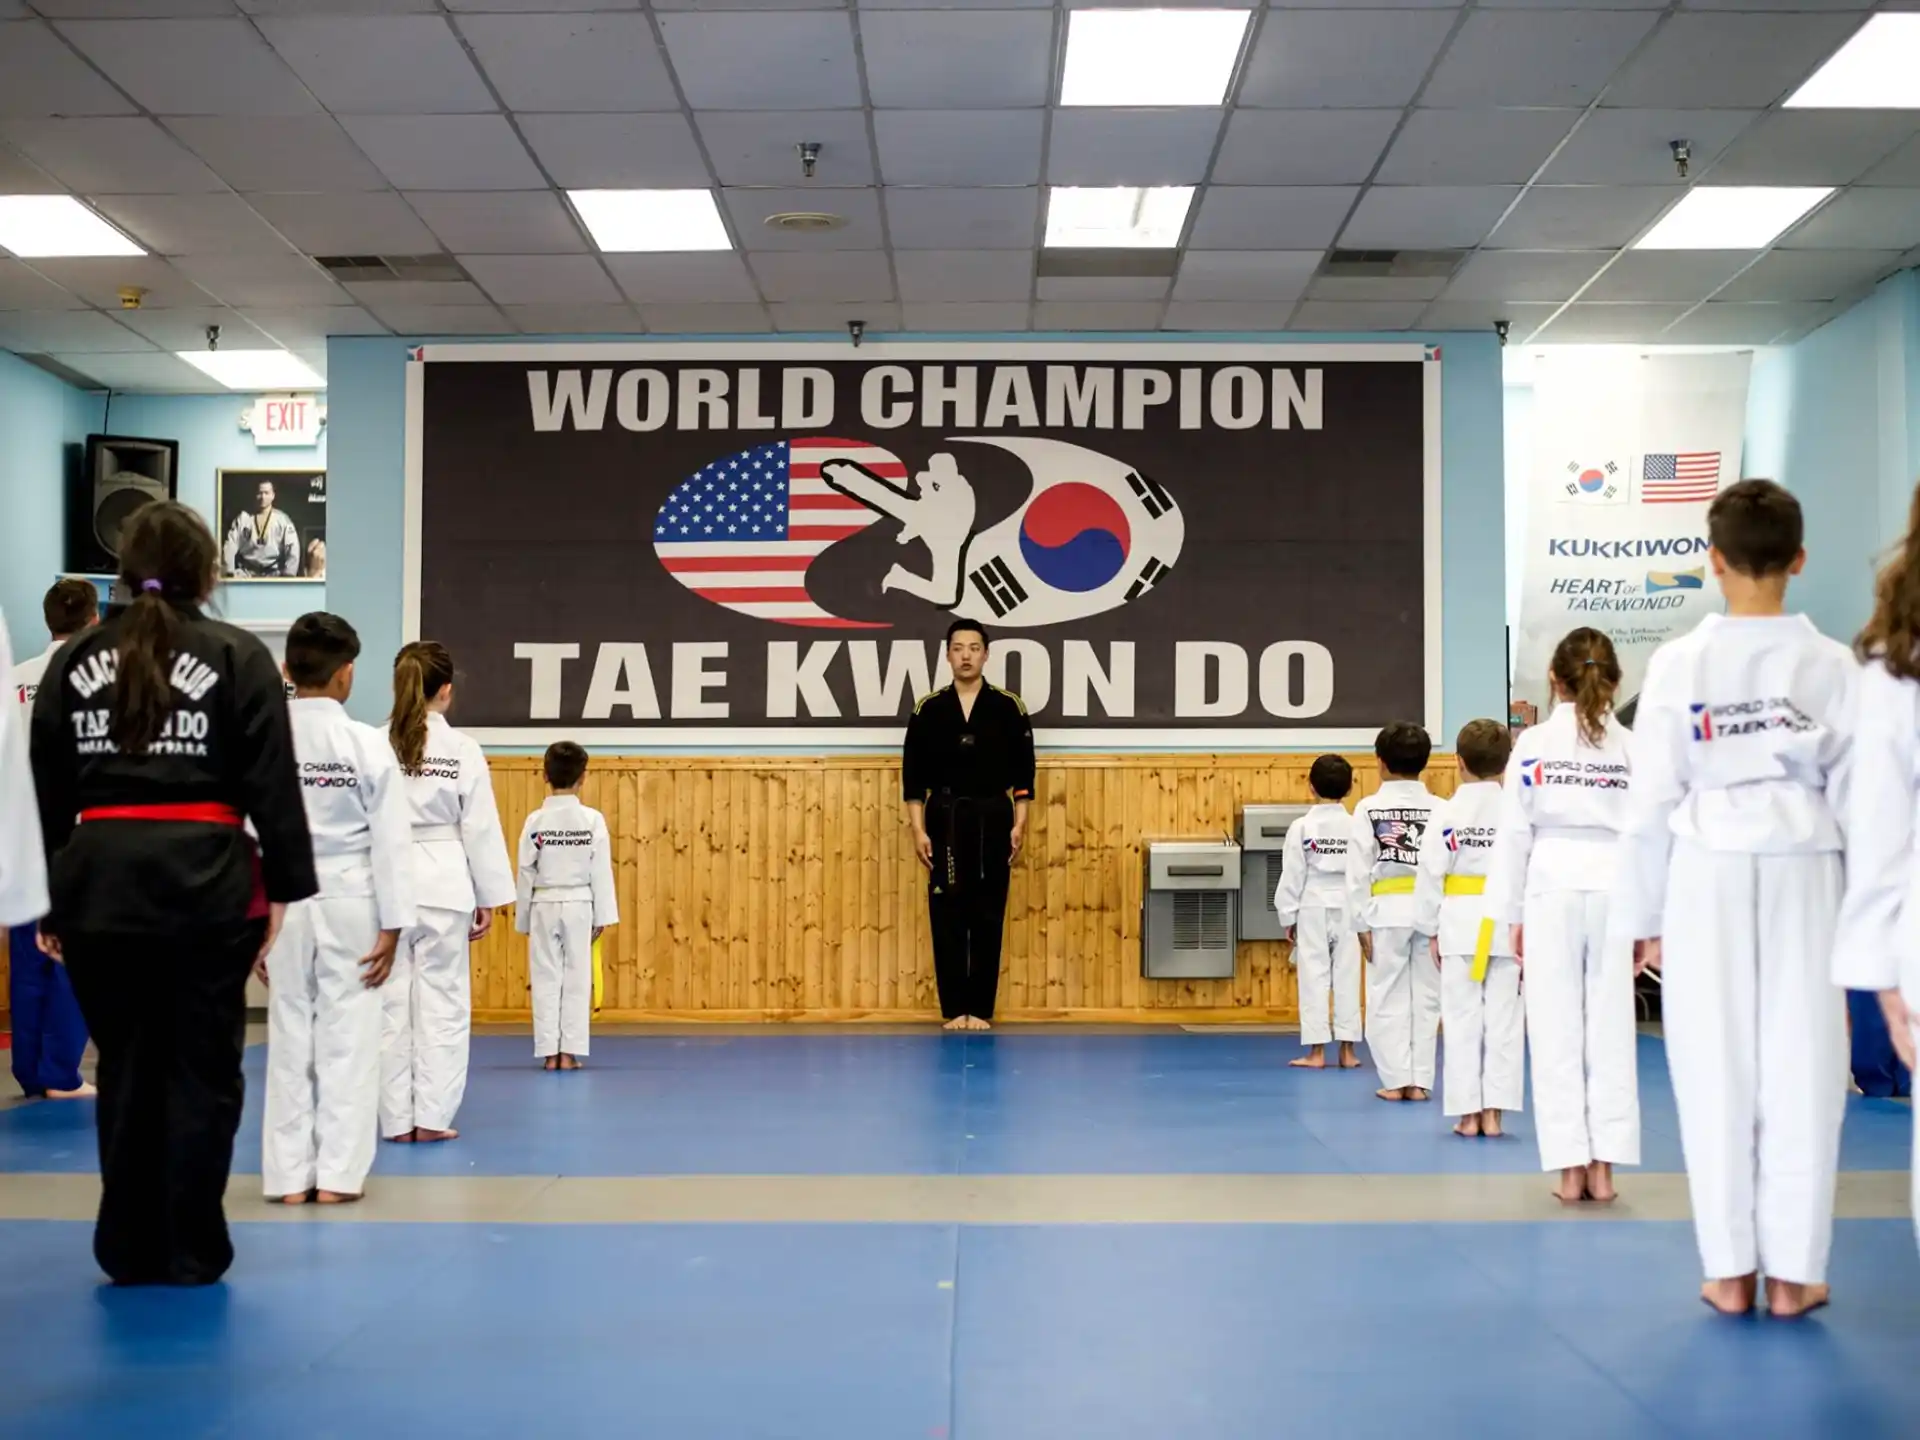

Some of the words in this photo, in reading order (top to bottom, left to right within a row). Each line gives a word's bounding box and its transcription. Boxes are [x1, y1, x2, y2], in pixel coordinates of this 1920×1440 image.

[527, 367, 835, 431] WORLD
[860, 365, 1324, 431] CHAMPION
[266, 403, 307, 431] EXIT
[1549, 537, 1711, 559] KUKKIWON
[1550, 578, 1626, 595] HEART
[1567, 595, 1685, 611] TAEKWONDO
[170, 653, 219, 701] CLUB
[514, 641, 731, 720] TAE
[766, 638, 1136, 719] KWON
[1175, 640, 1334, 720] DO
[72, 709, 109, 739] TAE
[177, 710, 208, 740] DO
[1543, 761, 1582, 771] WORLD
[298, 776, 358, 788] WONDO
[1545, 775, 1628, 790] TAEKWOND
